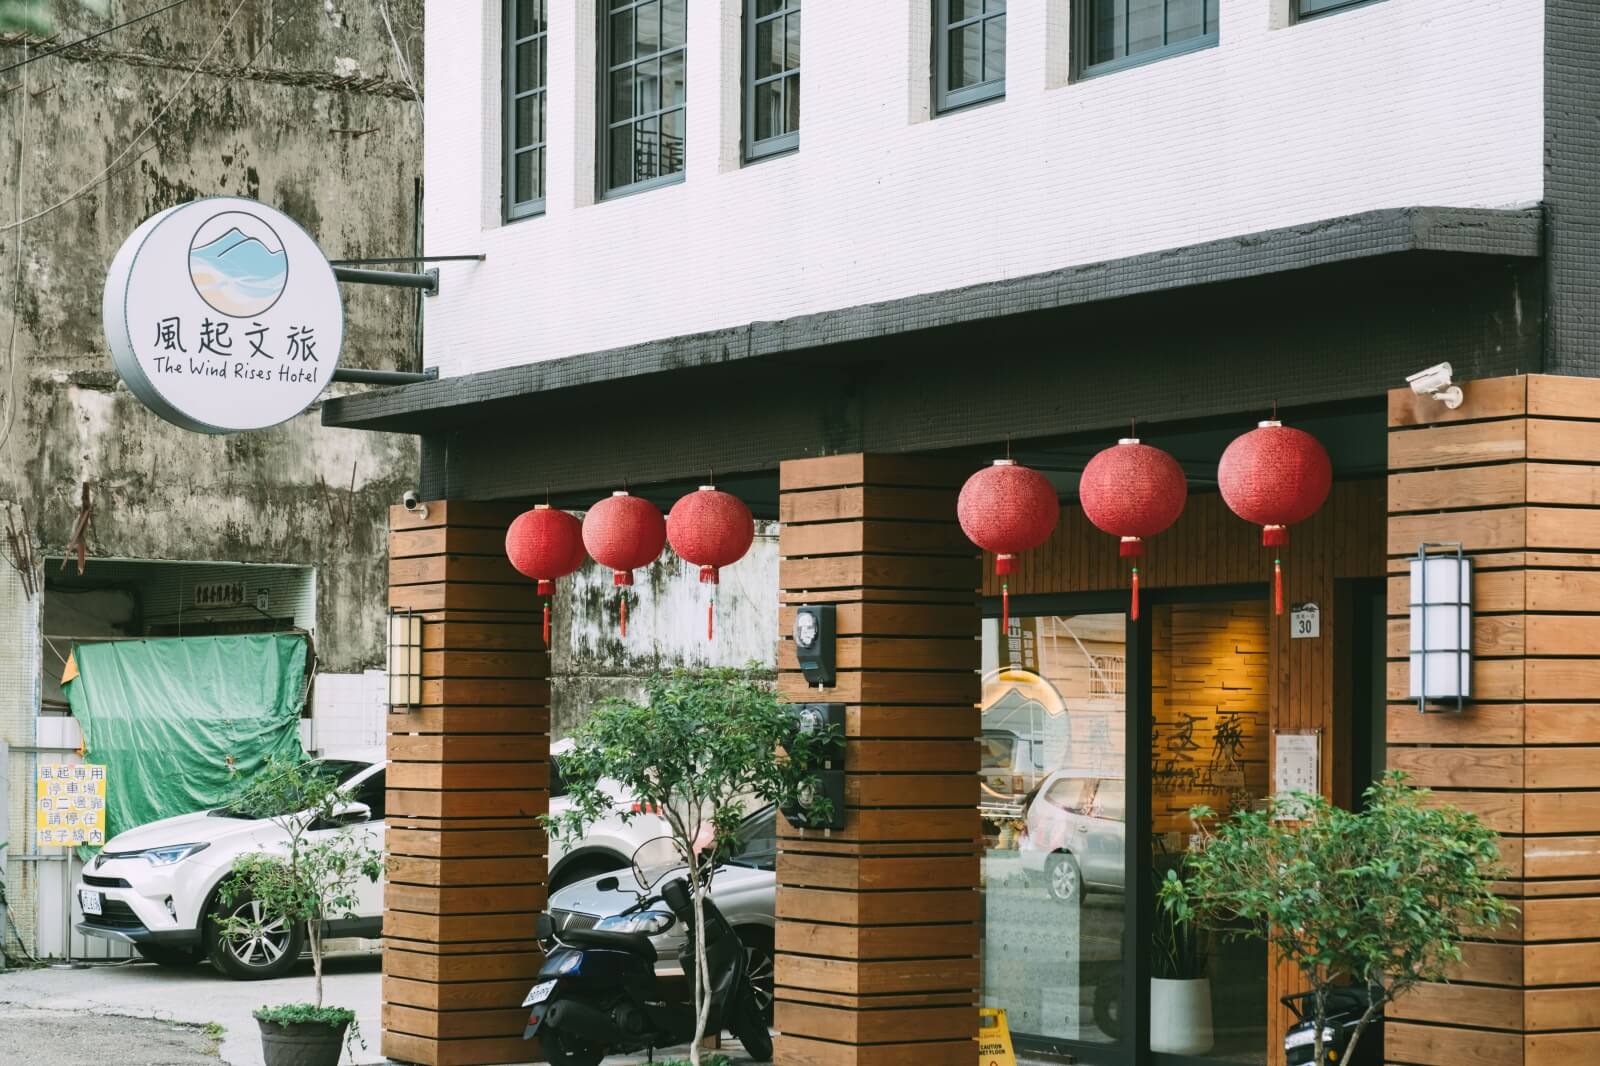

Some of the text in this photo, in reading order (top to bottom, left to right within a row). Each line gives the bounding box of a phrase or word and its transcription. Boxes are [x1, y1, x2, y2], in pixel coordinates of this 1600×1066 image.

[153, 316, 319, 362] 風起文旅
[153, 356, 318, 384] The Wind Rises Hotel
[1299, 619, 1312, 634] 30
[41, 766, 103, 780] 風起專用
[48, 781, 97, 796] 停車場
[48, 812, 97, 825] 請停在
